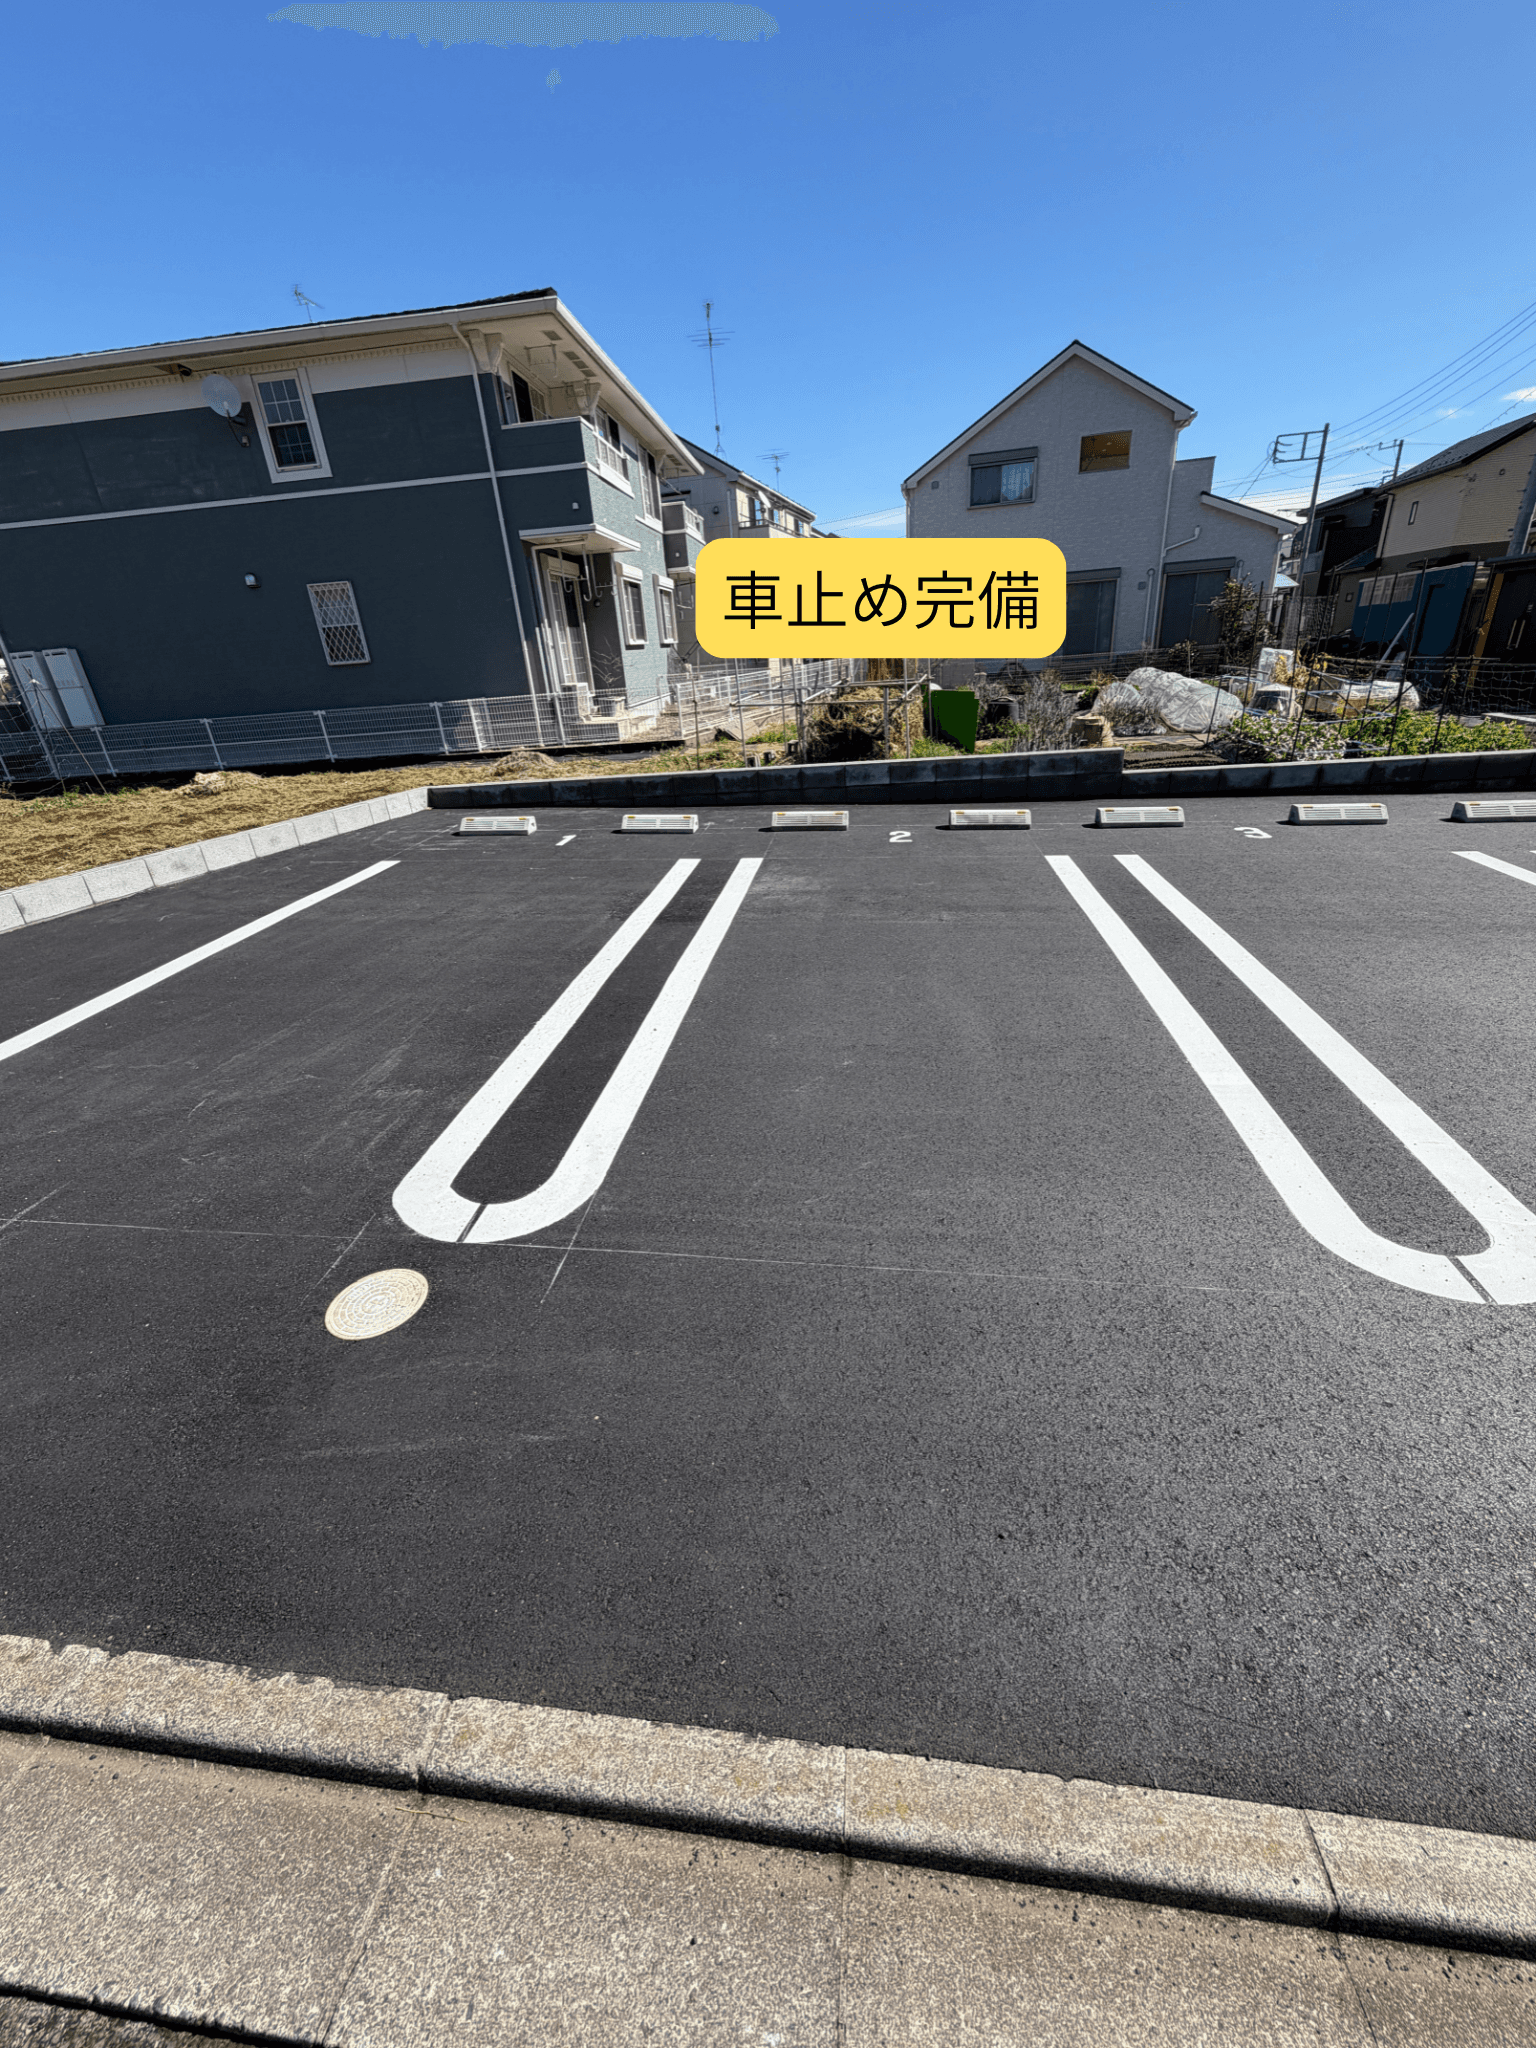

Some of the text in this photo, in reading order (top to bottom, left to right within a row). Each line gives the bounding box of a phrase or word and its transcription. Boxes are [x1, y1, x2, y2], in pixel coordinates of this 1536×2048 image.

[889, 830, 912, 843] 2
[1234, 826, 1273, 839] 3
[555, 834, 577, 846] 1
